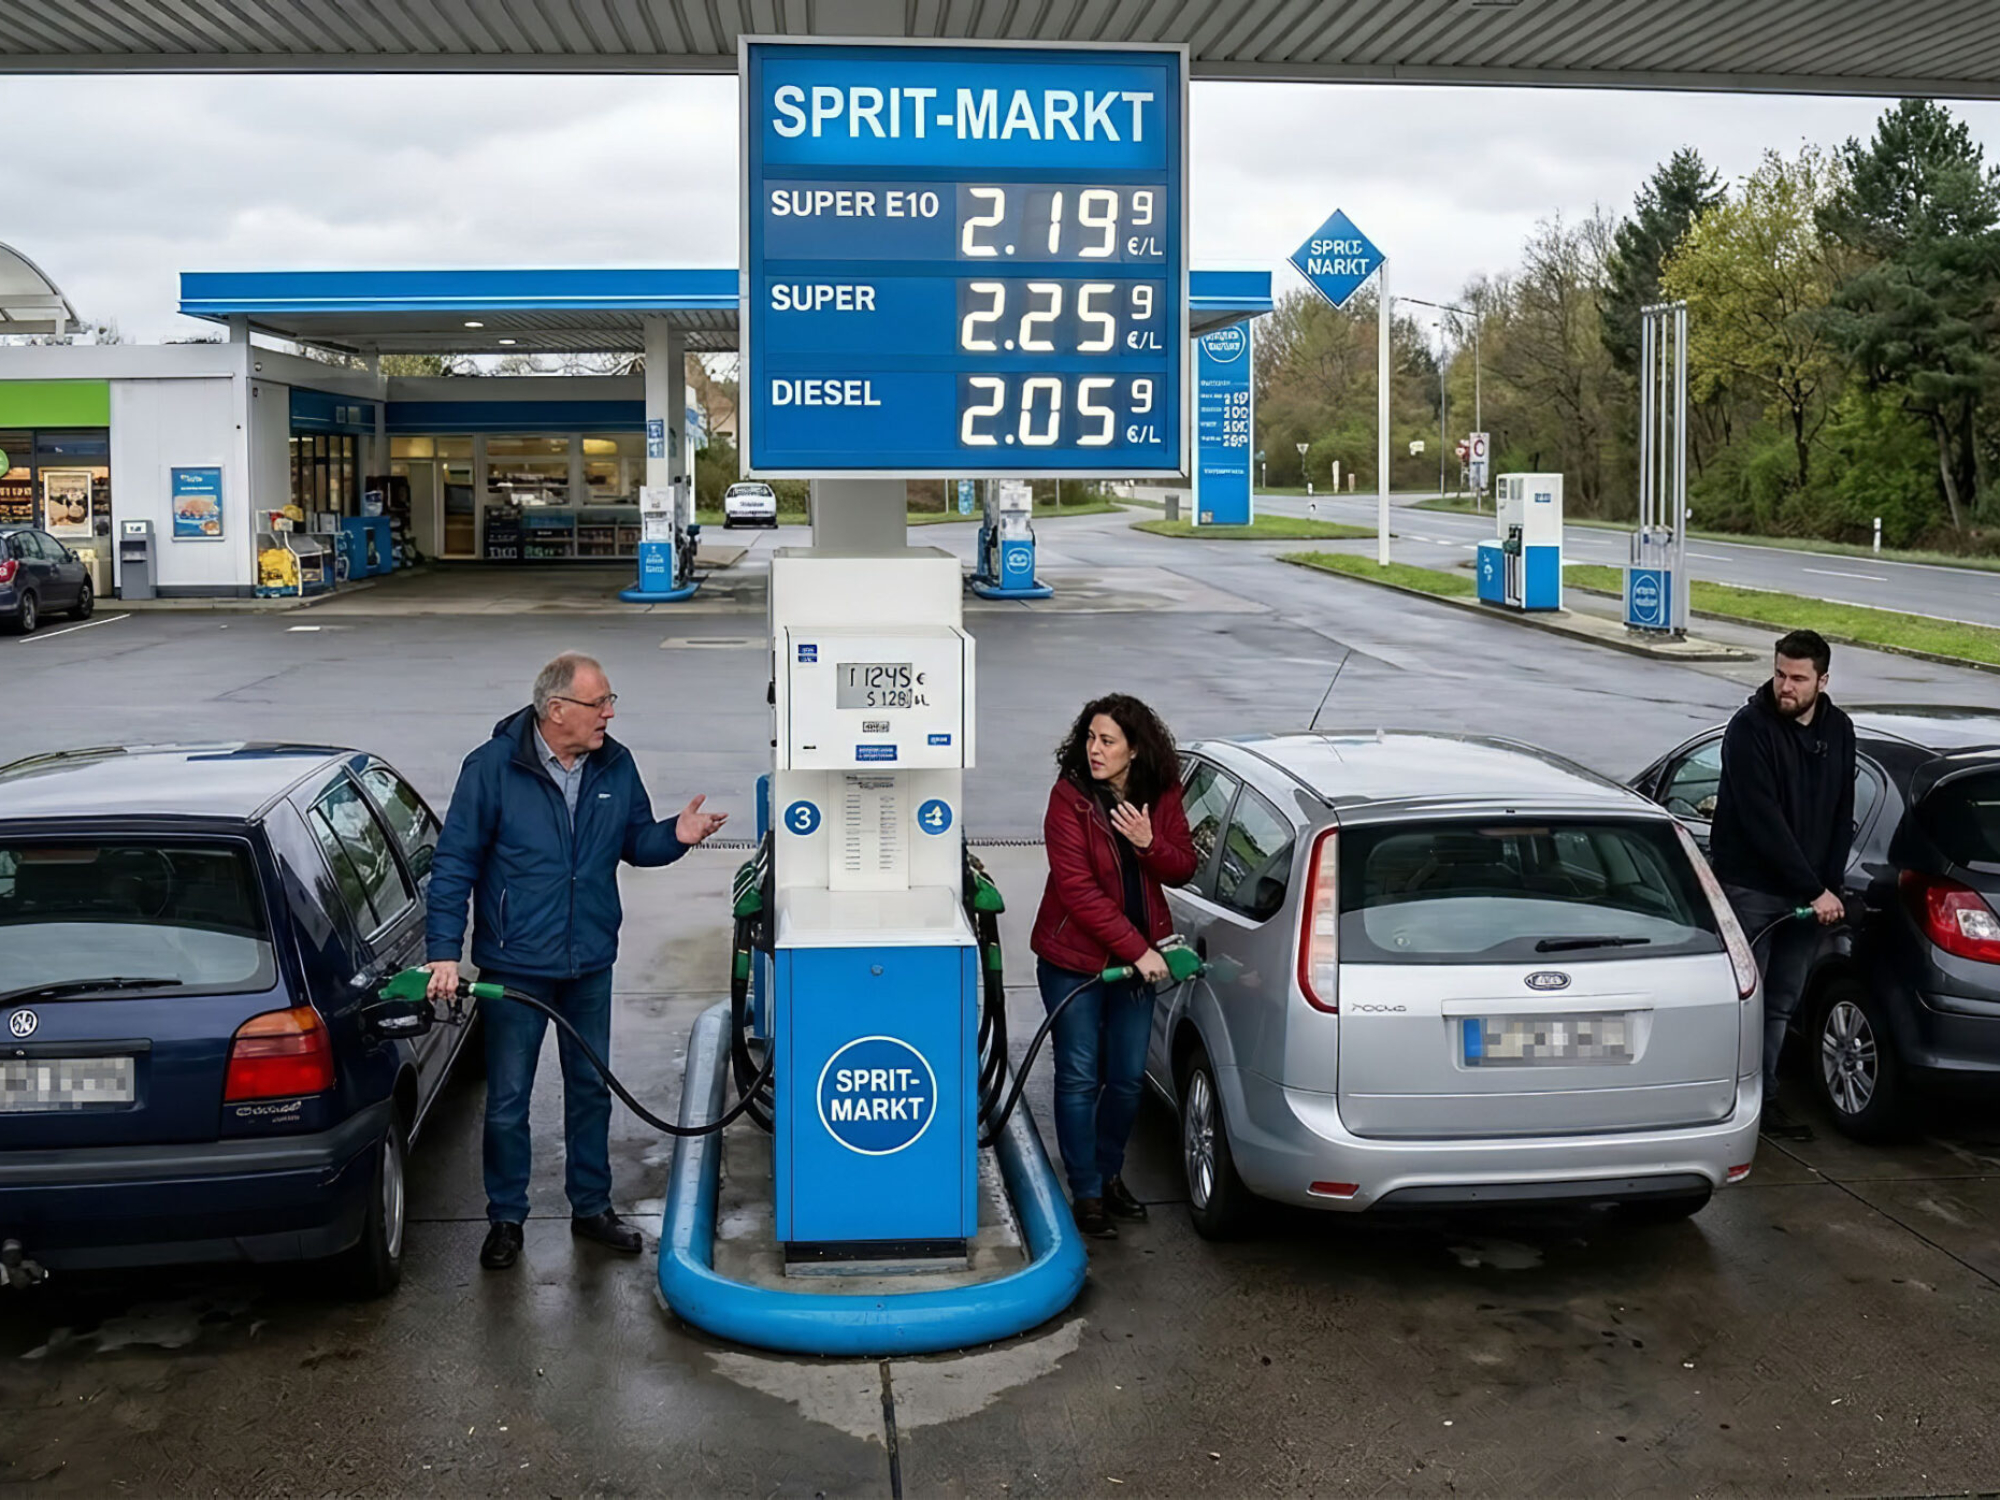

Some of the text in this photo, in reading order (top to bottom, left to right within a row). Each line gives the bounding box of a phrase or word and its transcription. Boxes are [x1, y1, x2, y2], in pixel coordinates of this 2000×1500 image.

[772, 85, 1155, 142] SPRIT-MARKT
[771, 187, 1154, 258] SUPER E10 2.19 9
[1127, 236, 1163, 256] €/L
[771, 282, 1153, 352] SUPER 2.25 9
[1127, 330, 1162, 350] €/L
[772, 377, 1153, 446] DIESEL 2.05 9
[1127, 425, 1161, 443] €/L
[794, 806, 811, 830] 3
[835, 1068, 920, 1092] SPRIT-
[831, 1097, 925, 1121] MARKT
